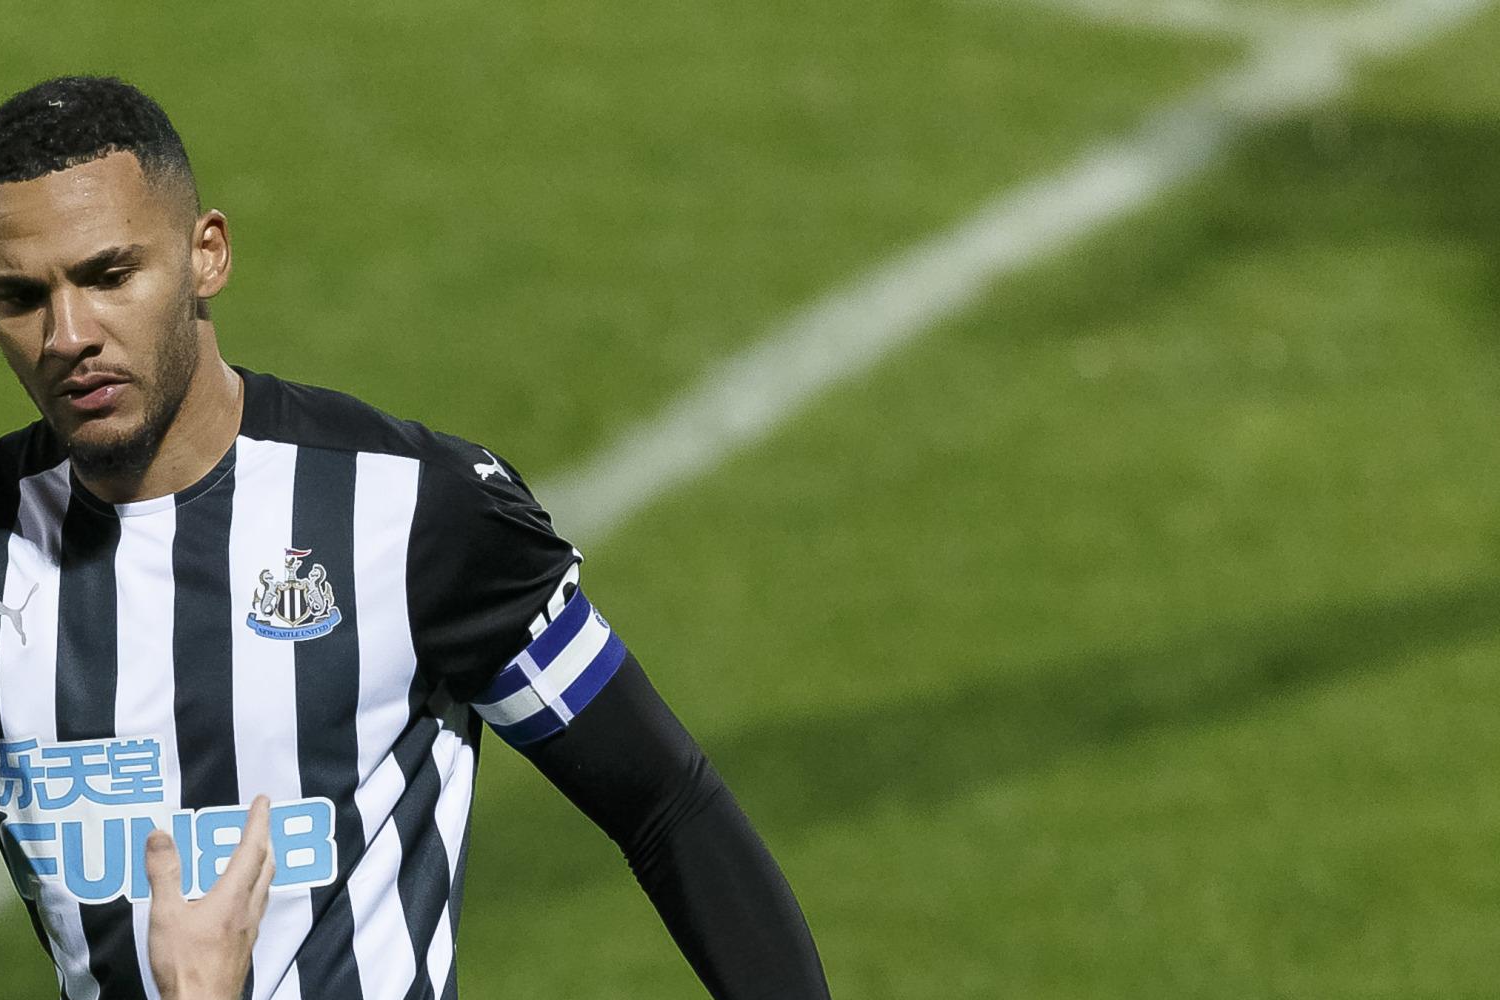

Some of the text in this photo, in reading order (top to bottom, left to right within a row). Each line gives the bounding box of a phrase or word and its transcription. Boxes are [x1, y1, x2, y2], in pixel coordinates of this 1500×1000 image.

[0, 738, 164, 809] 乐天堂
[5, 801, 334, 899] FUN88
